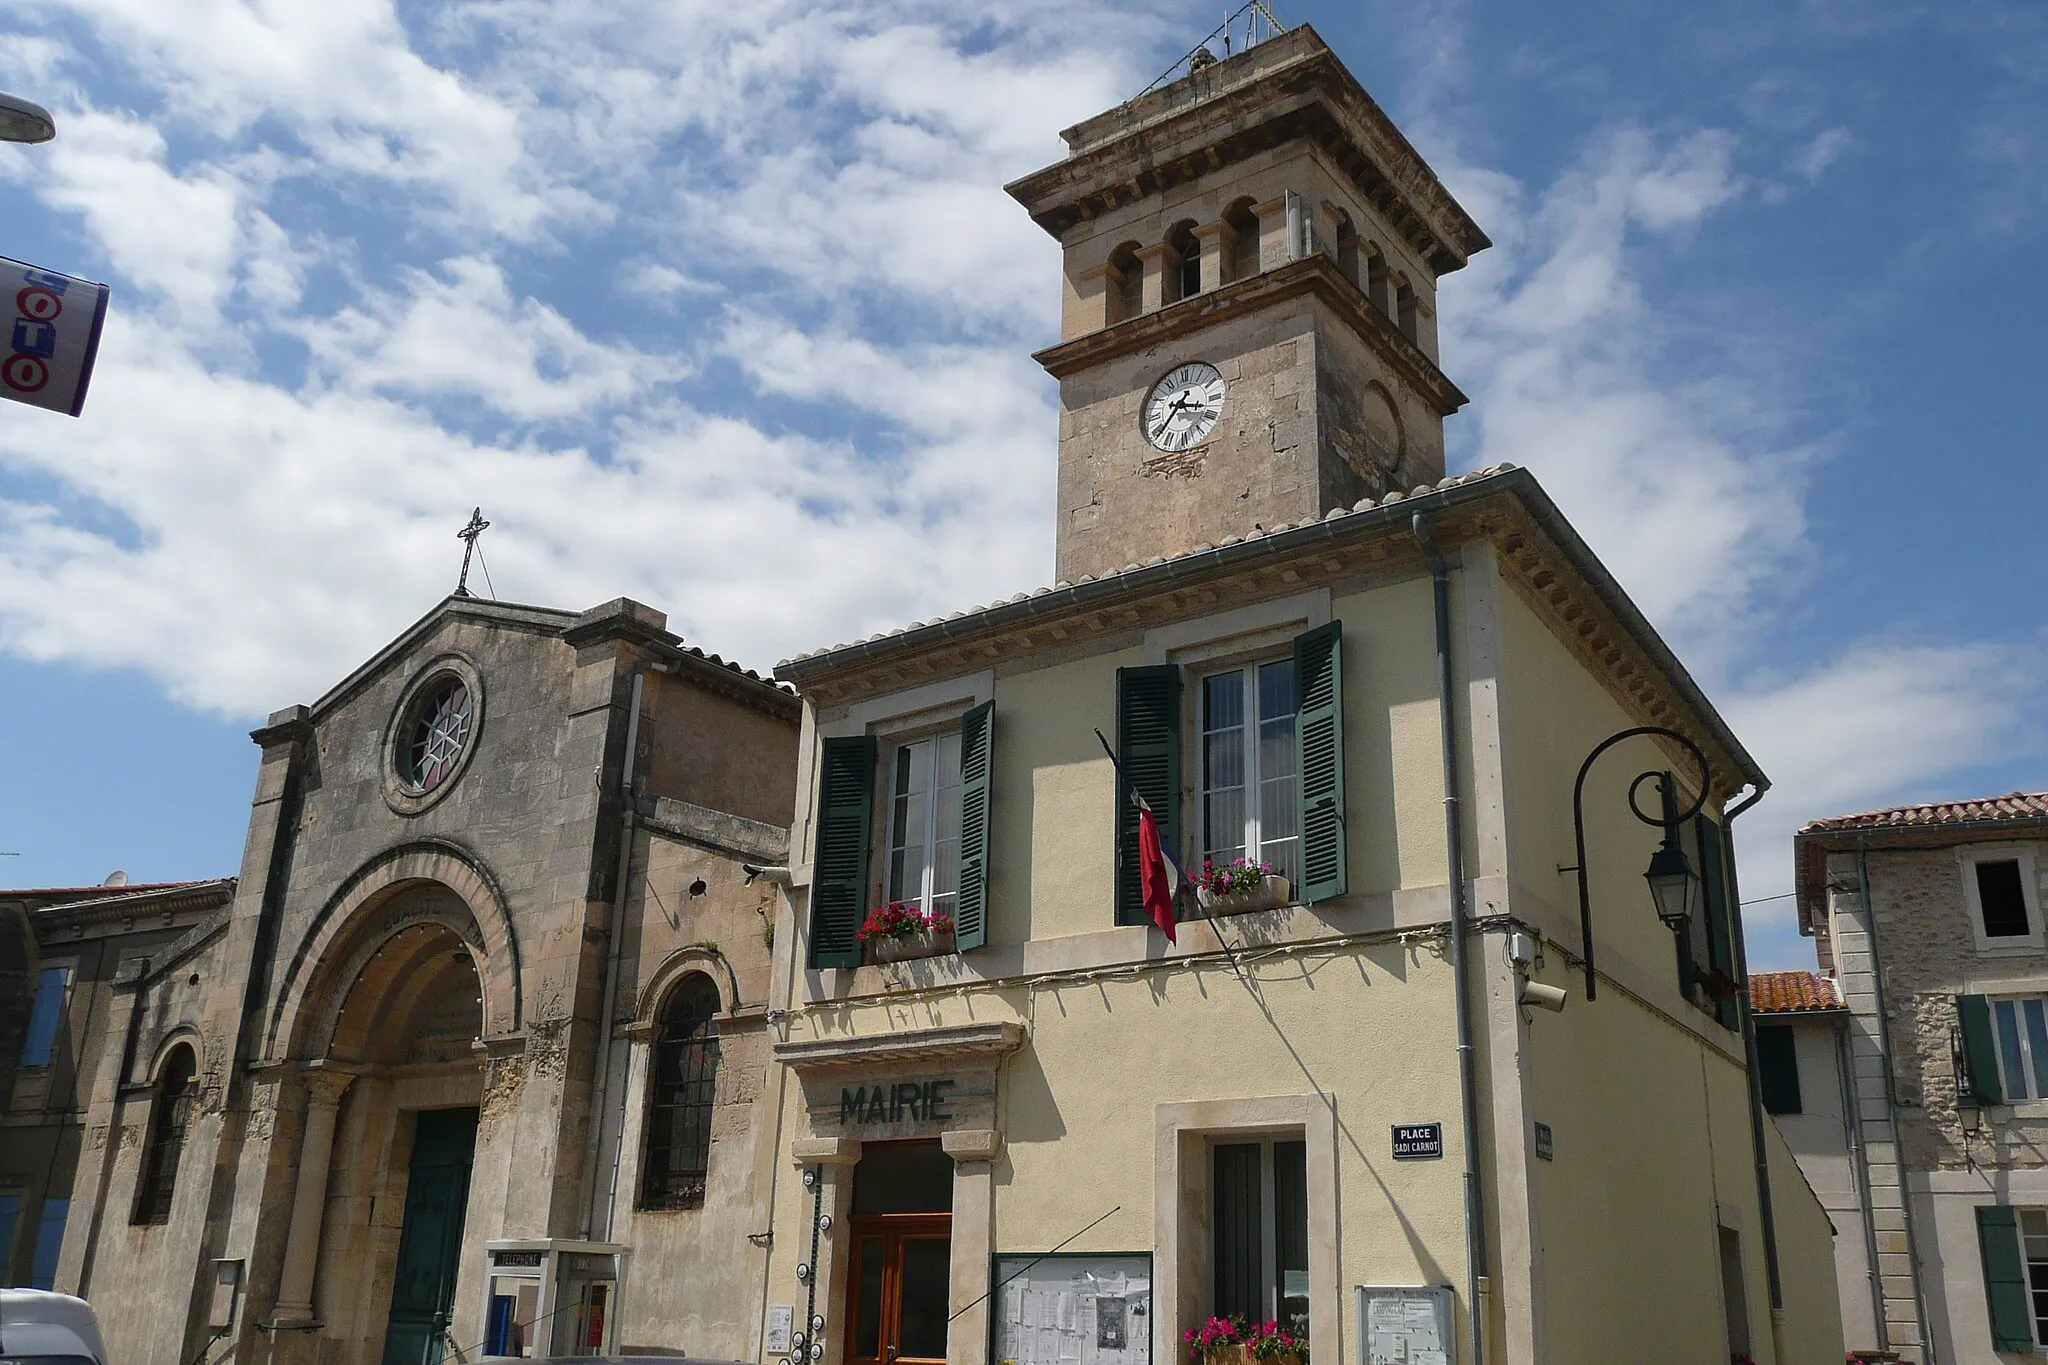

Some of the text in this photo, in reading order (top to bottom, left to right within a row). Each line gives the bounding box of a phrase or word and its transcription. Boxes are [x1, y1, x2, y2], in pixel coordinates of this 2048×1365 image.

[840, 1080, 955, 1125] MAIRIE
[1400, 1128, 1431, 1140] PLACE
[1394, 1141, 1438, 1153] SADI CARNOT
